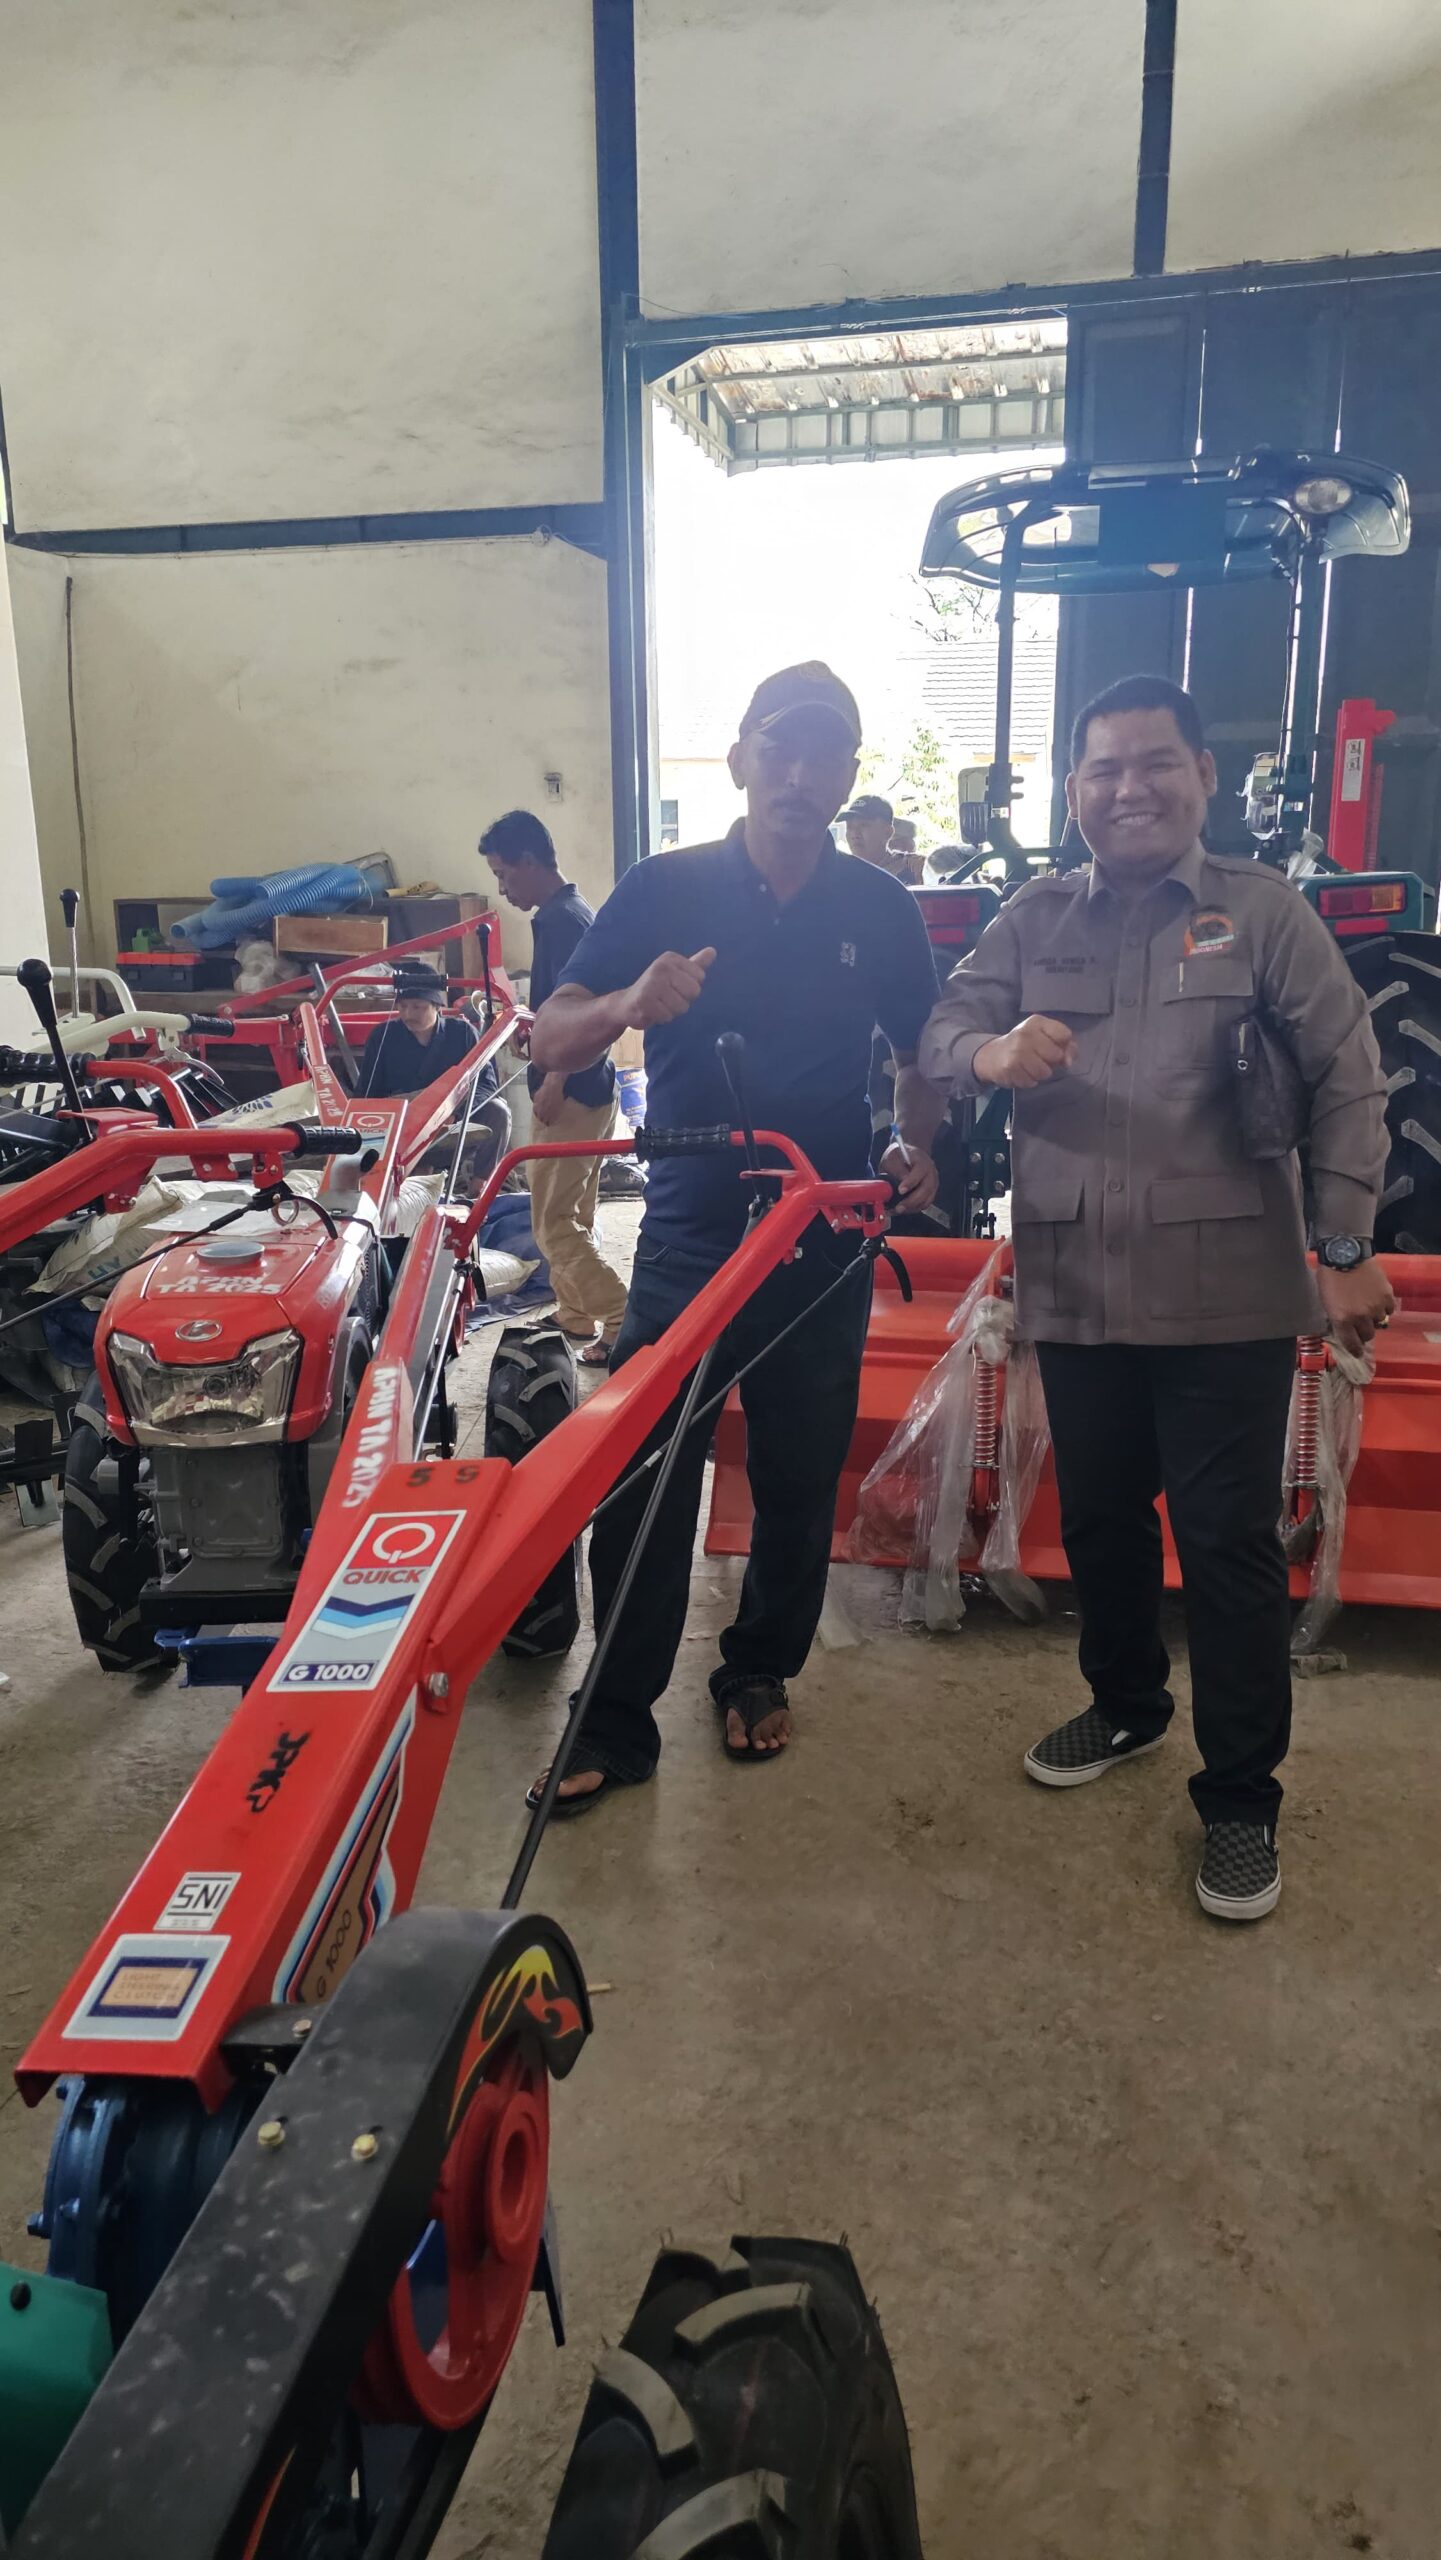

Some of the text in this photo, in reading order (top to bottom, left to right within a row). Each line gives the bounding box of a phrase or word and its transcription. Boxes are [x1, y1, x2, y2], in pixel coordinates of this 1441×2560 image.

[205, 1283, 283, 1295] 2025
[358, 1417, 393, 1453] TA
[342, 1568, 428, 1585] QUICK
[288, 1663, 371, 1681] G 1000
[171, 1883, 229, 1910] SNI
[326, 1909, 352, 1974] 1000
